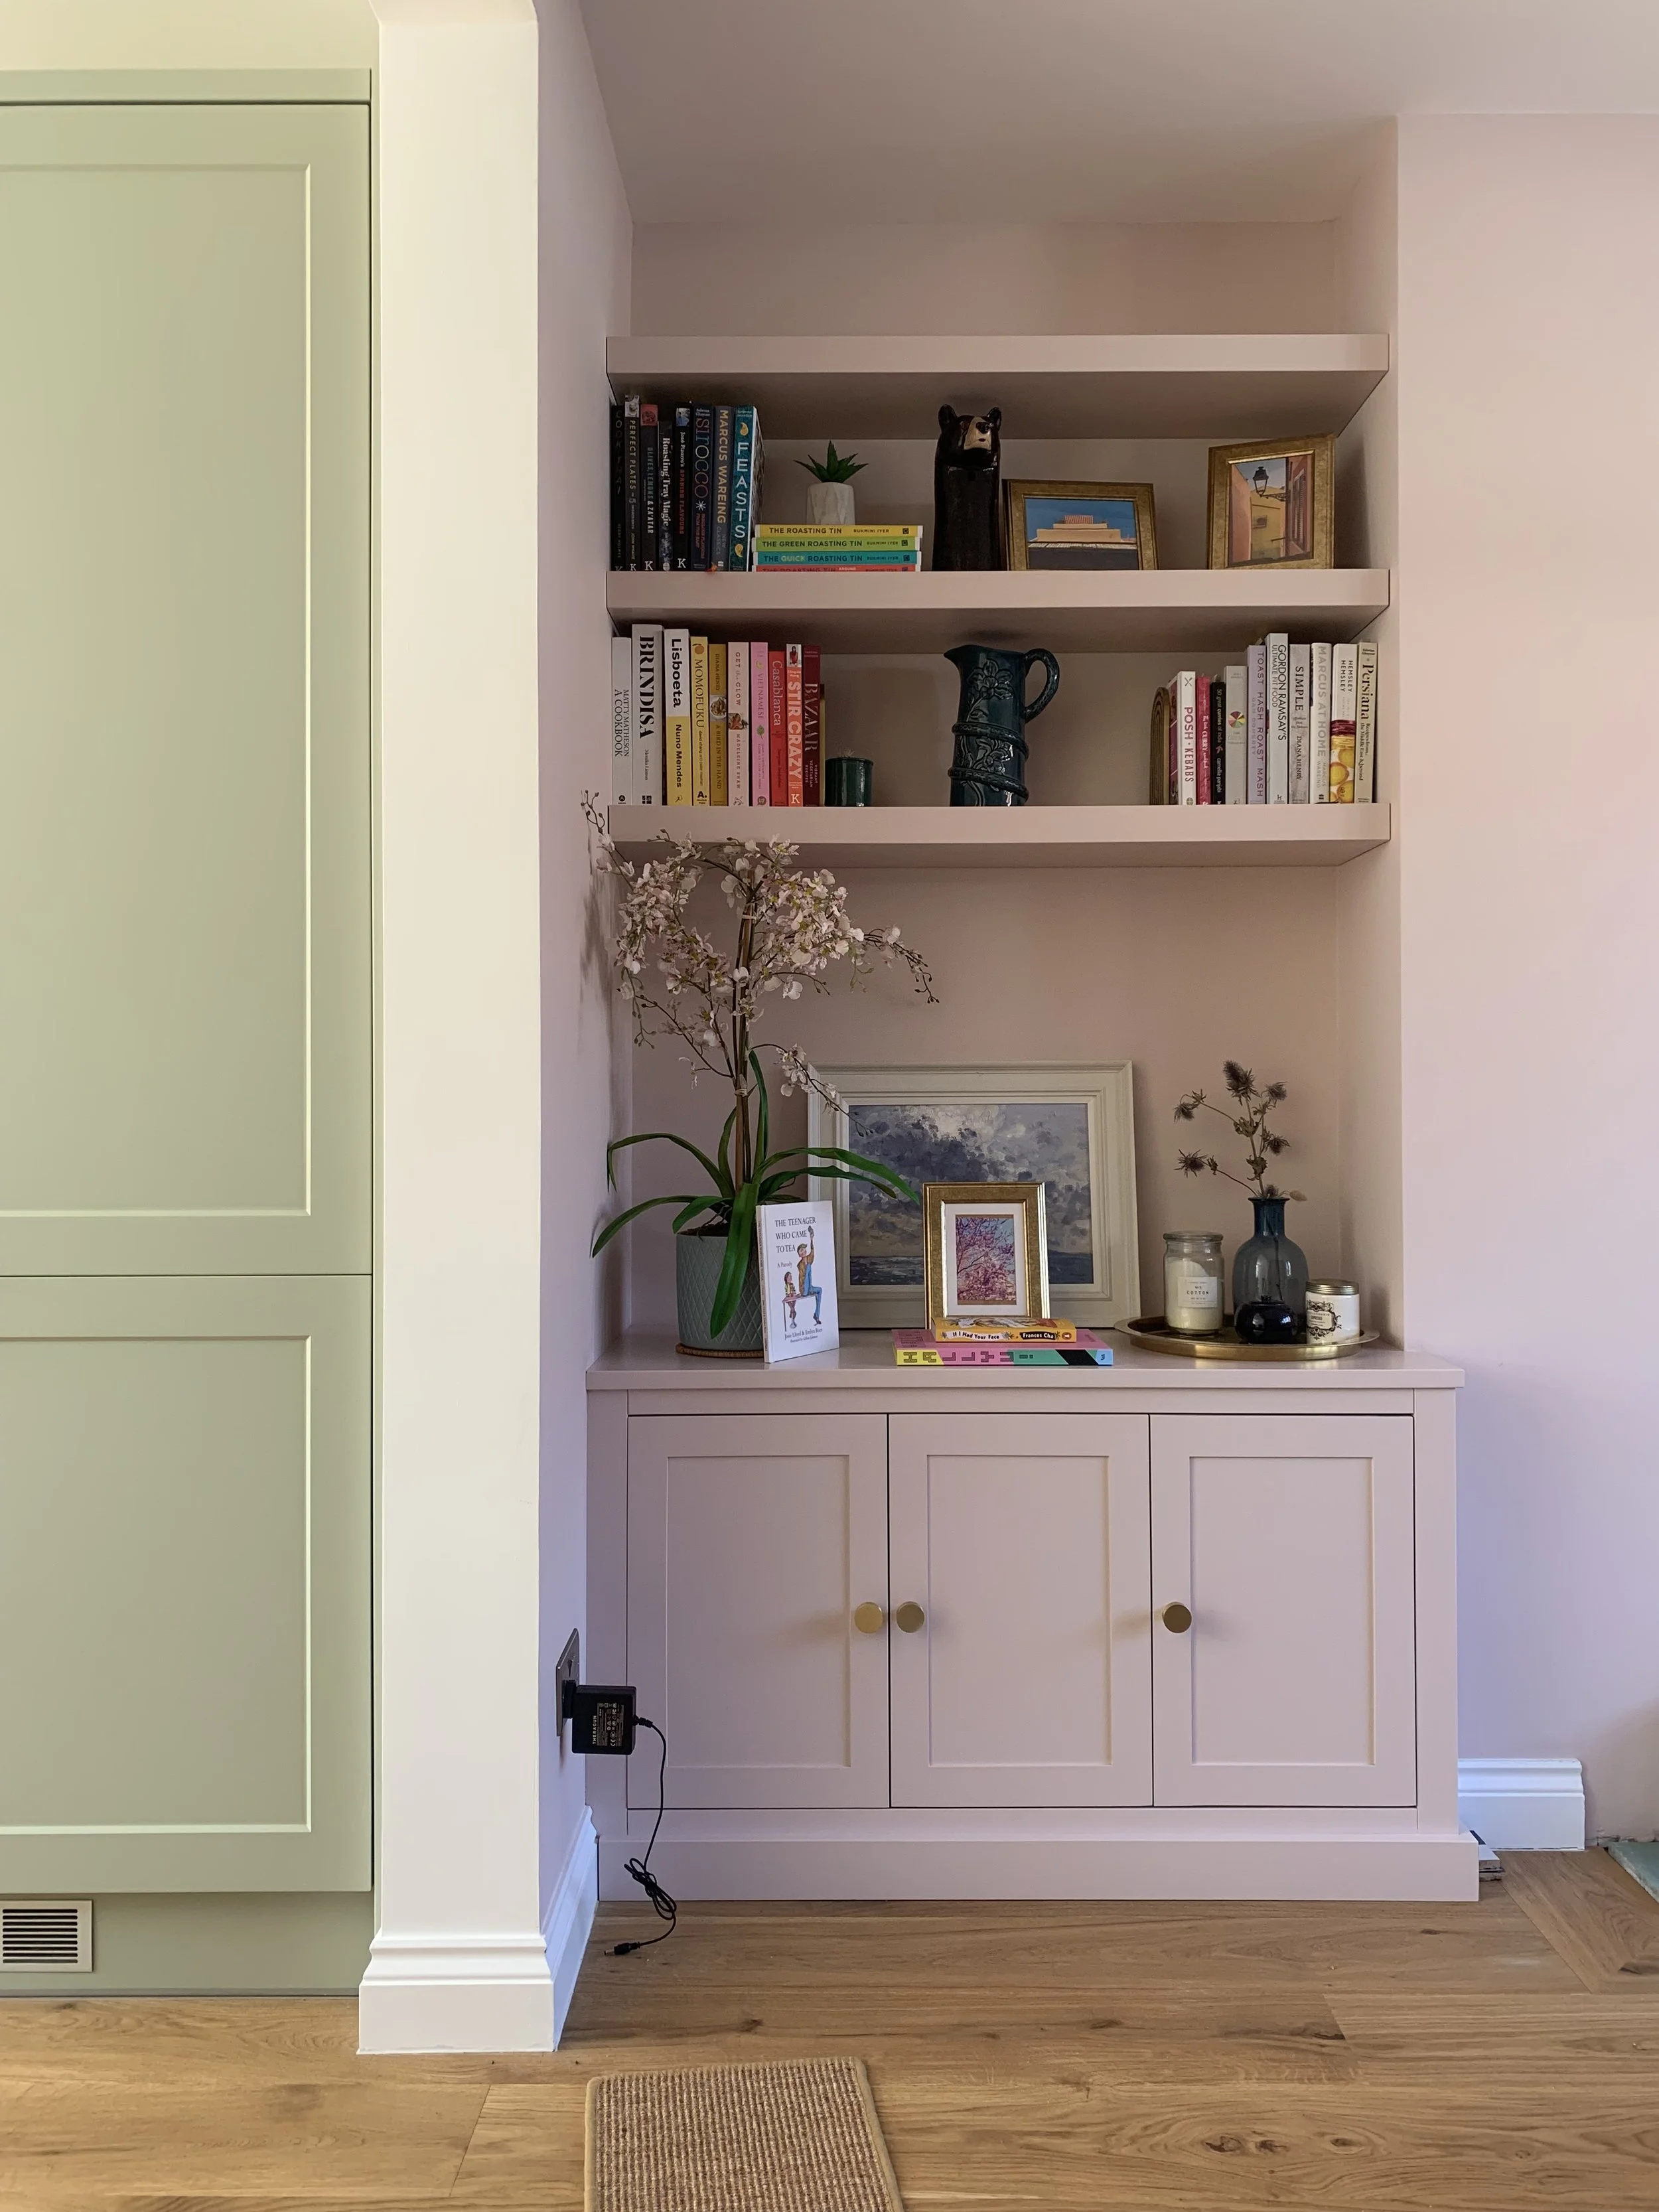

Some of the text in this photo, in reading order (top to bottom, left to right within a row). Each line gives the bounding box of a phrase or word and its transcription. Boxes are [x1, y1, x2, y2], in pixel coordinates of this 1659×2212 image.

[660, 438, 671, 477] Roasting
[717, 409, 729, 524] MARCUS WAREING
[660, 478, 671, 498] Tray
[661, 500, 672, 526] Magic
[734, 442, 750, 539] FEASTS
[644, 561, 654, 571] K
[677, 558, 687, 569] K
[639, 636, 655, 739] BRINDISA
[672, 638, 683, 708] Lisboeta
[695, 659, 705, 728] MOMOFUKU
[772, 660, 784, 726] Casablanca
[788, 681, 802, 717] STIR
[1277, 644, 1287, 741] GORDON RAMSAY'S
[1295, 666, 1304, 711] SIMPLE
[1361, 664, 1374, 719] Persiana
[804, 683, 818, 752] BAZAAR
[1318, 646, 1327, 757] MARCUS AT HOME
[788, 721, 802, 779] CRAZY
[1185, 706, 1194, 782] POSH KEBABS
[790, 793, 800, 804] K
[788, 1217, 816, 1226] TEENAGER
[792, 1230, 808, 1238] CAME
